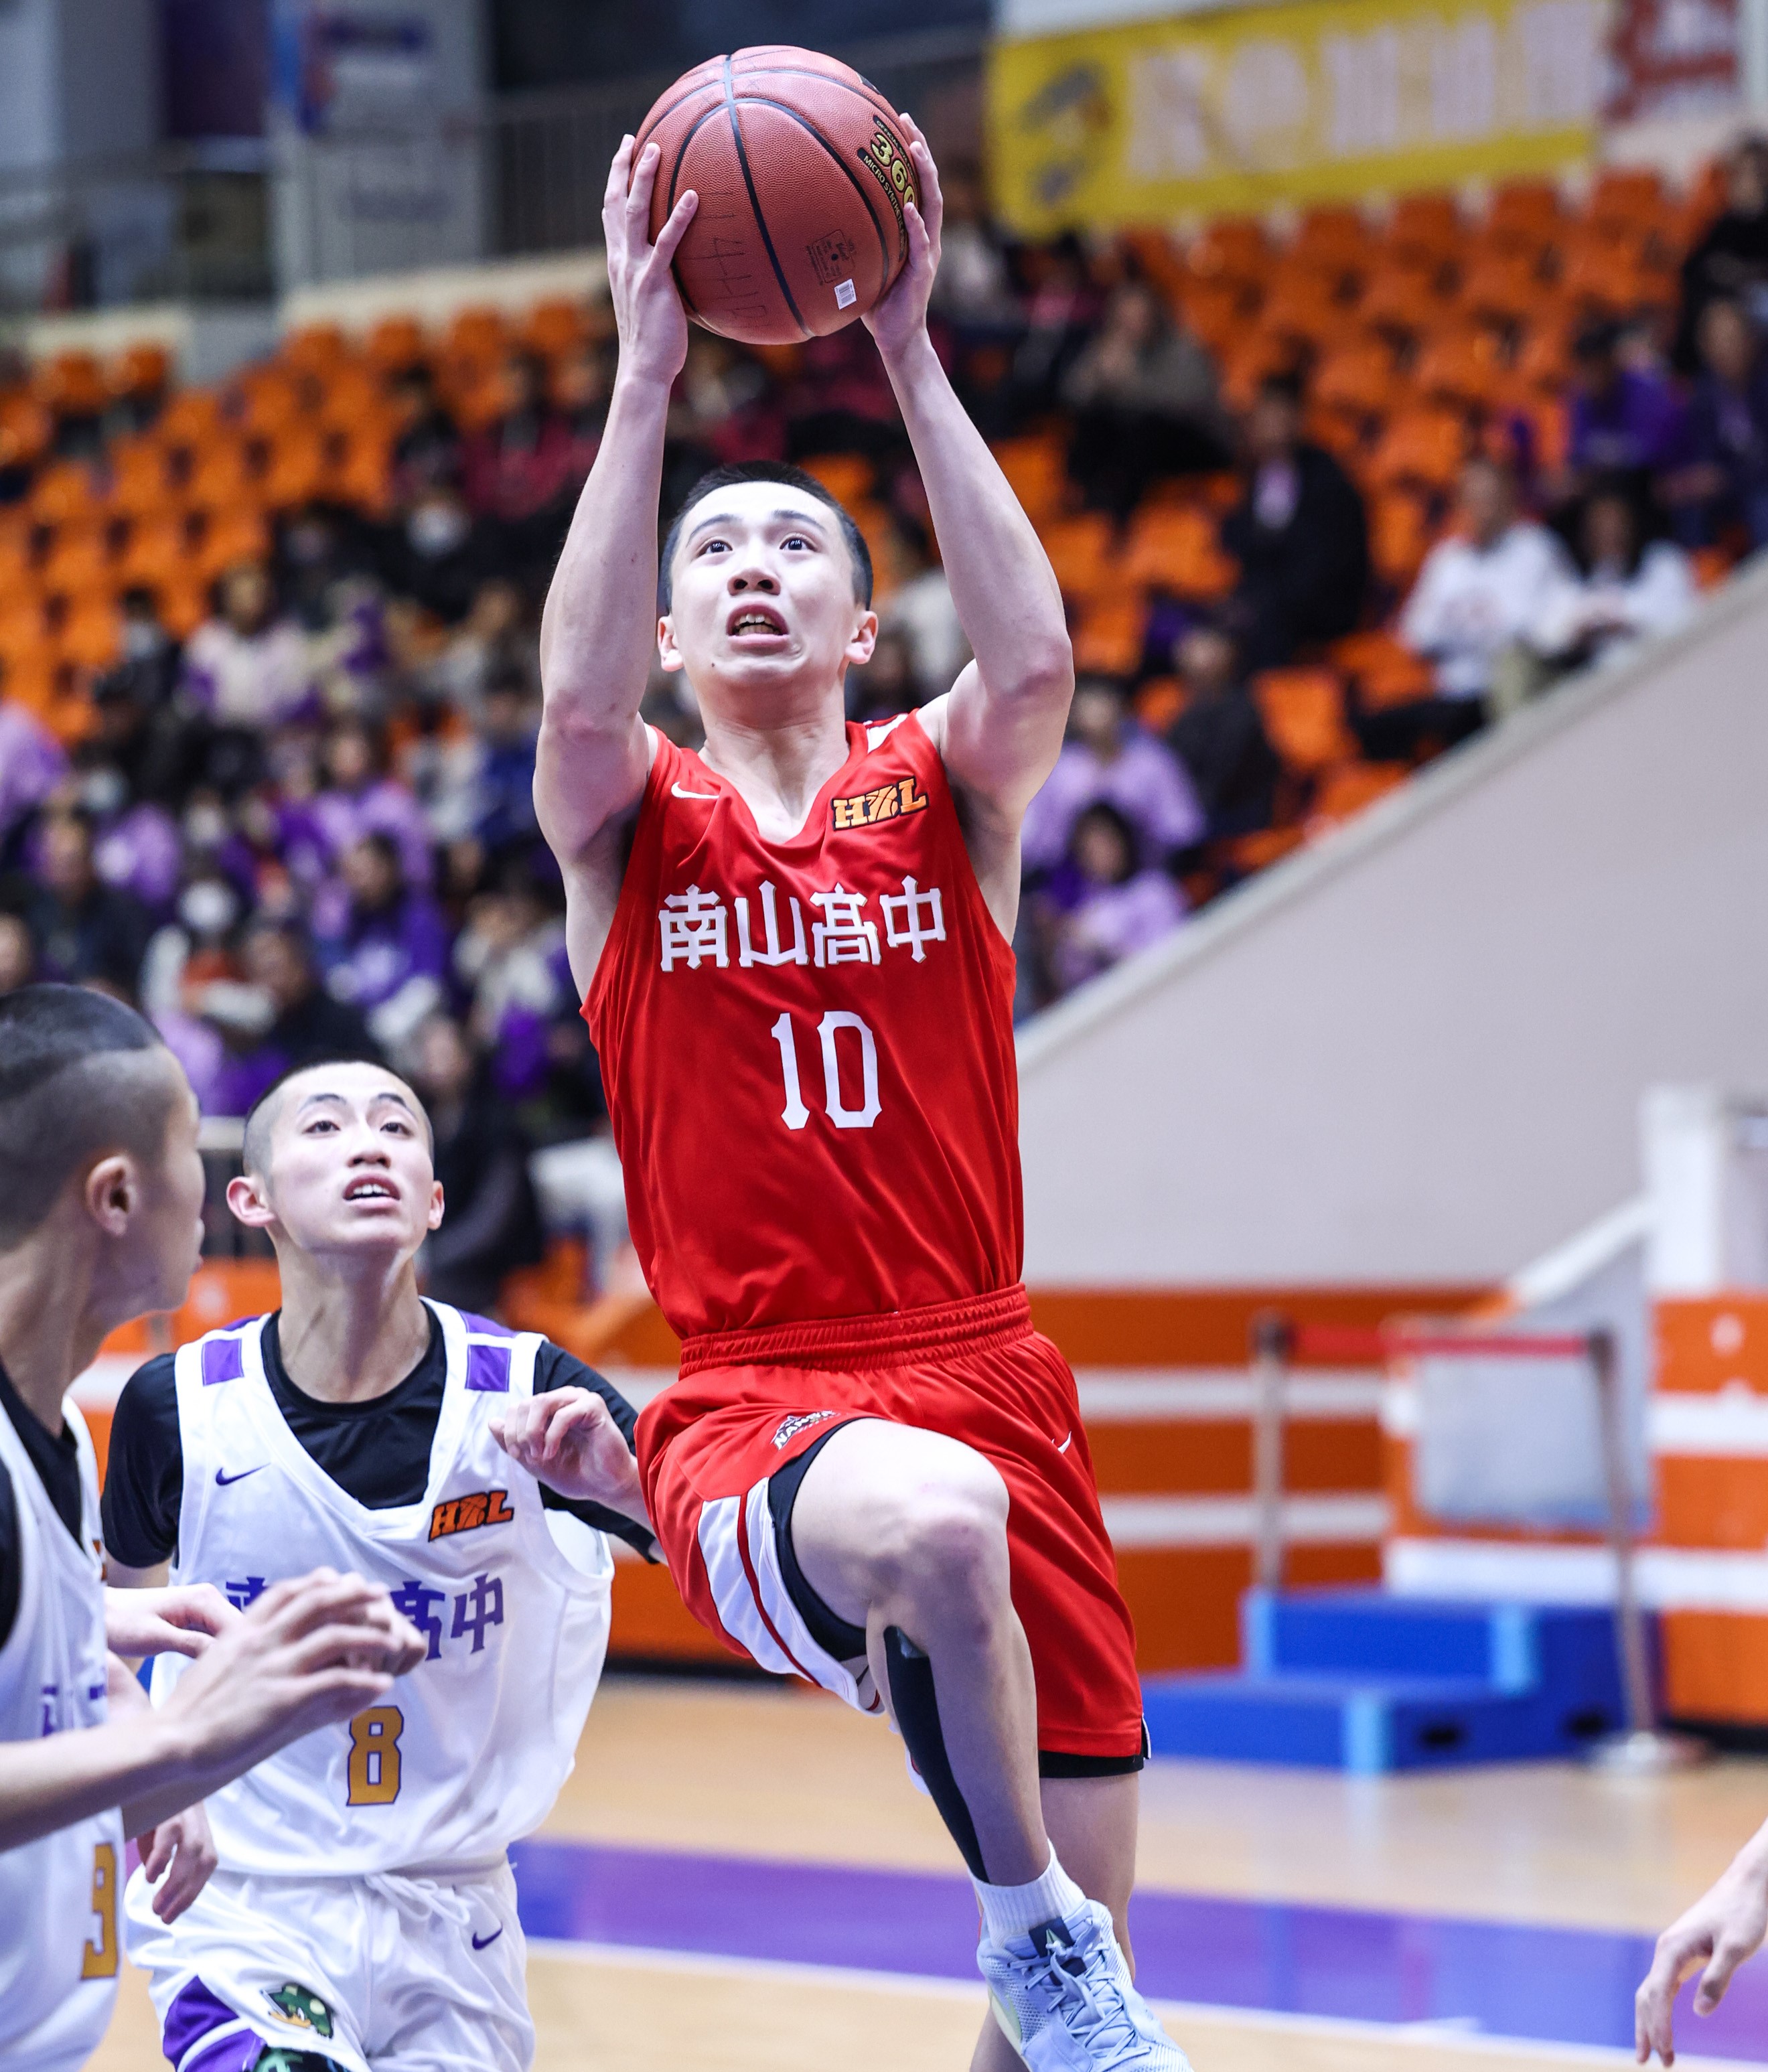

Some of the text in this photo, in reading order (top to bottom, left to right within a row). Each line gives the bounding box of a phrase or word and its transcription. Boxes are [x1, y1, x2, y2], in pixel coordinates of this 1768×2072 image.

[863, 155, 885, 183] MICRO
[870, 131, 916, 204] 360
[830, 775, 930, 831] HBL
[771, 1011, 882, 1130] 10
[428, 1490, 514, 1542] HBL
[346, 1705, 404, 1807] 8
